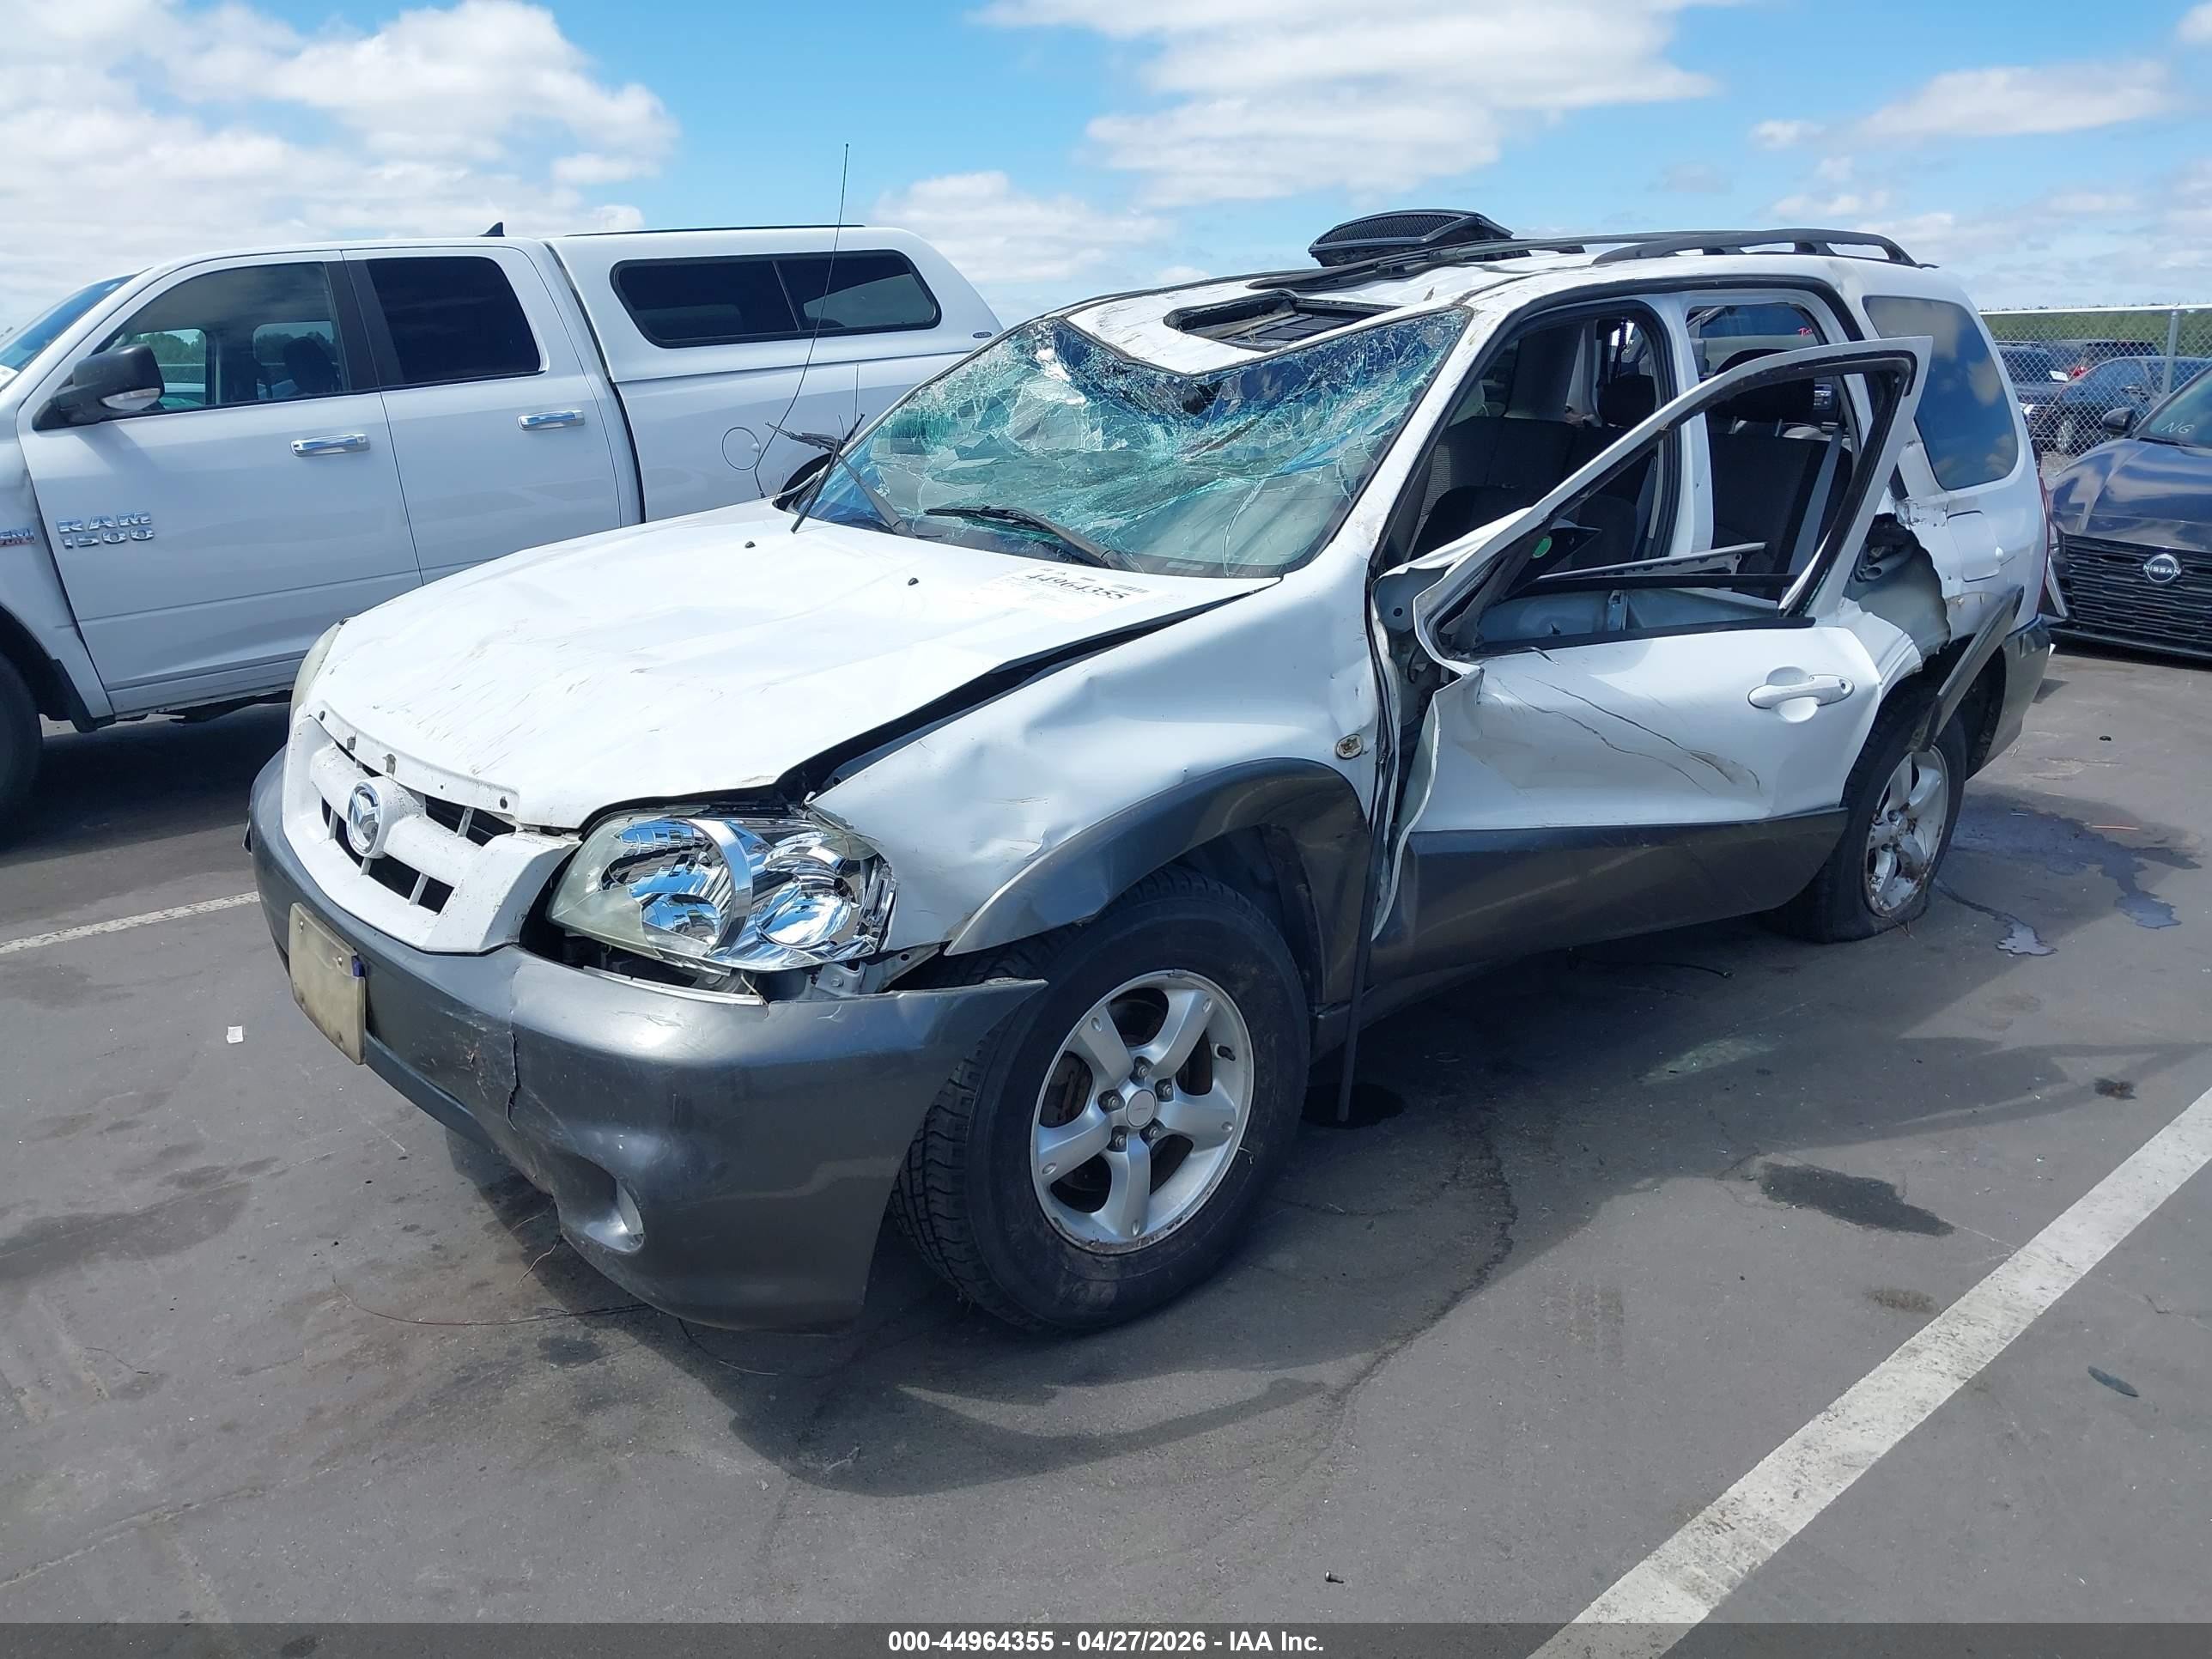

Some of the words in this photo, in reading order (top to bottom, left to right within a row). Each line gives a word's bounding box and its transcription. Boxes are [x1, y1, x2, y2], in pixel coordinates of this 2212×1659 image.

[57, 512, 151, 532] RAM
[61, 527, 154, 549] 1500
[2142, 563, 2182, 575] NISSAN
[1025, 574, 1131, 599] 44964355
